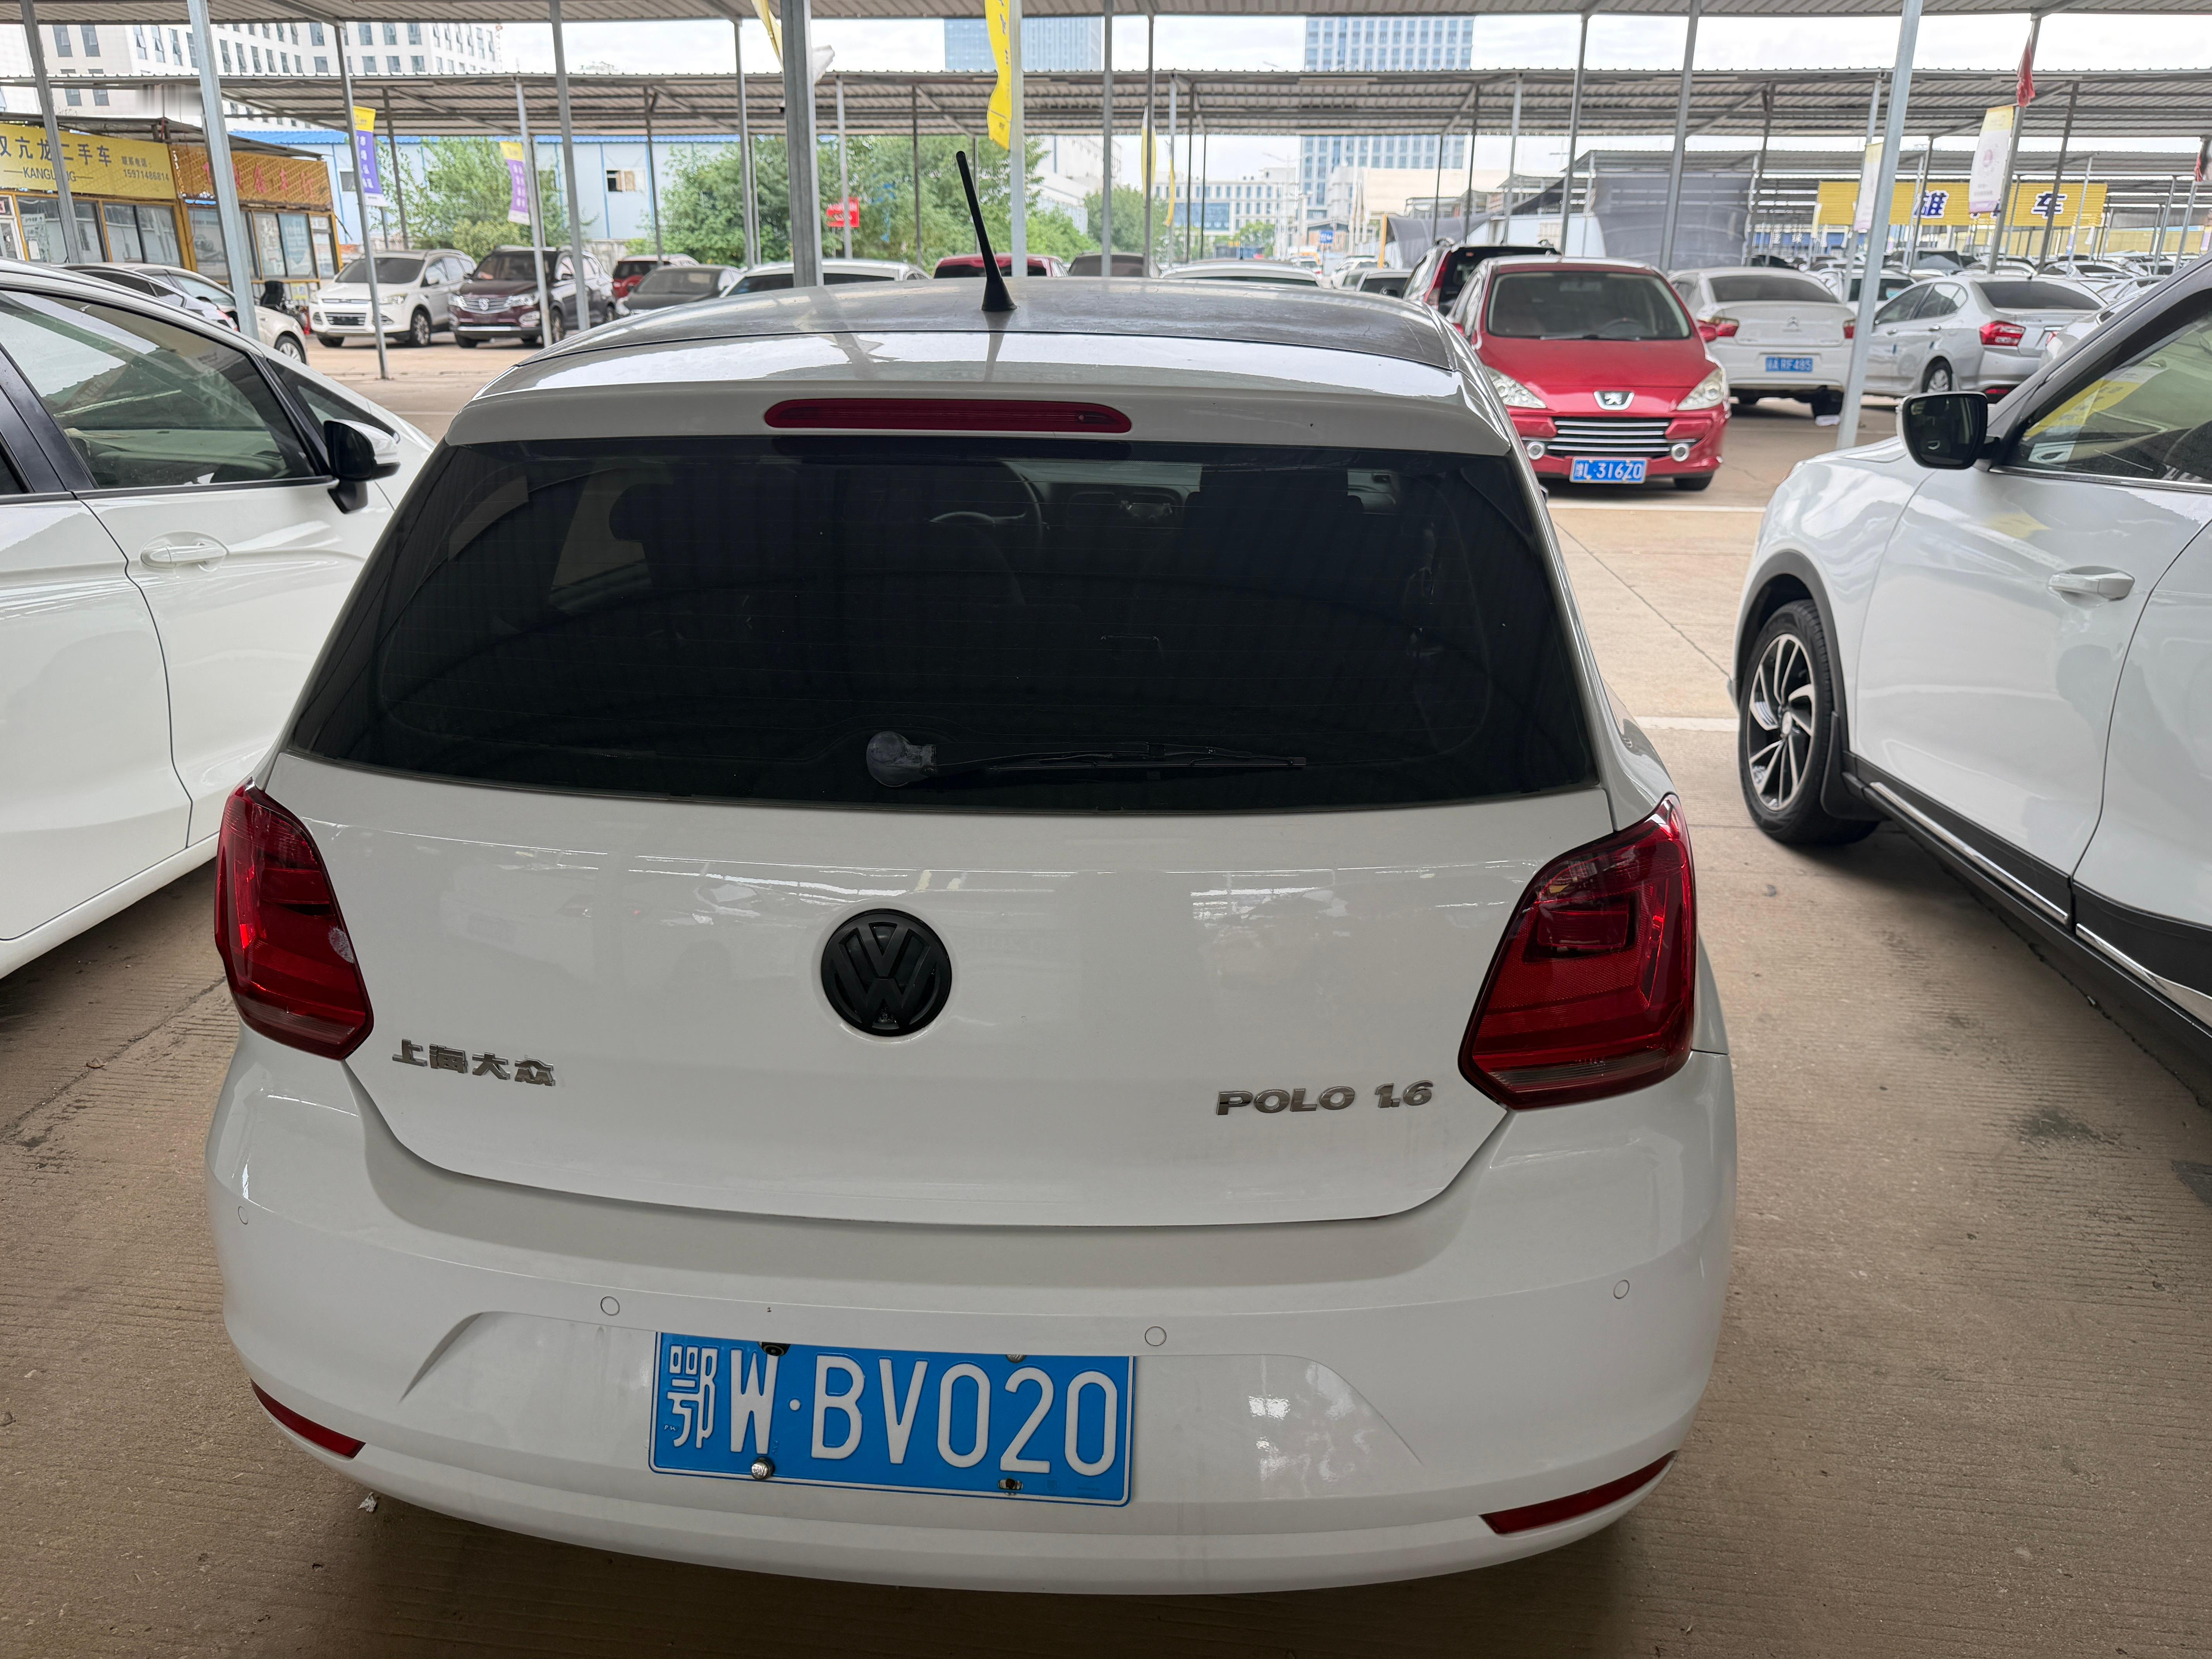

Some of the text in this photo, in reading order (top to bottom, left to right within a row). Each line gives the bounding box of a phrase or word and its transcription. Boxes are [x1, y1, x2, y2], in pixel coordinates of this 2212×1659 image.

[23, 167, 76, 182] KANGLG
[392, 1039, 556, 1086] 上海大众
[1216, 1080, 1434, 1115] POLO 1.6
